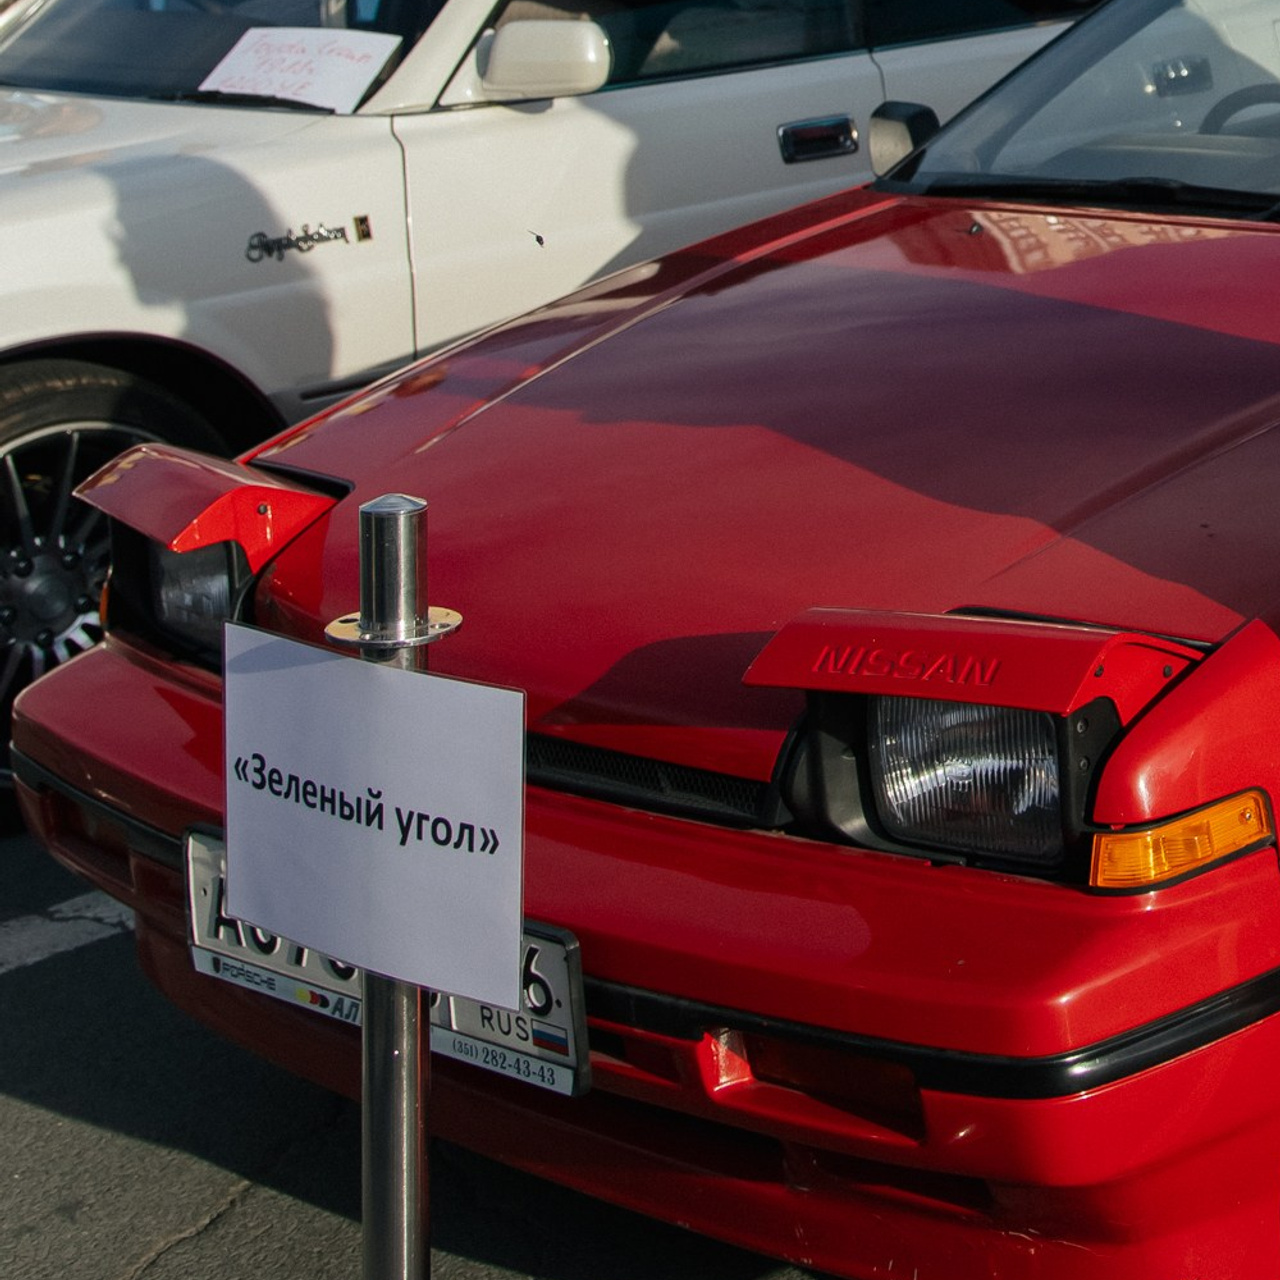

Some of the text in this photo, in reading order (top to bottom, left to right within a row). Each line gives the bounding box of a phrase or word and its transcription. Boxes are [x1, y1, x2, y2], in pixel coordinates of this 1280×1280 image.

[811, 645, 1001, 686] NISSAN
[233, 752, 500, 855] «Зеленый угол»
[480, 1004, 530, 1042] RUS
[452, 1038, 556, 1086] (351) 282-43-43
